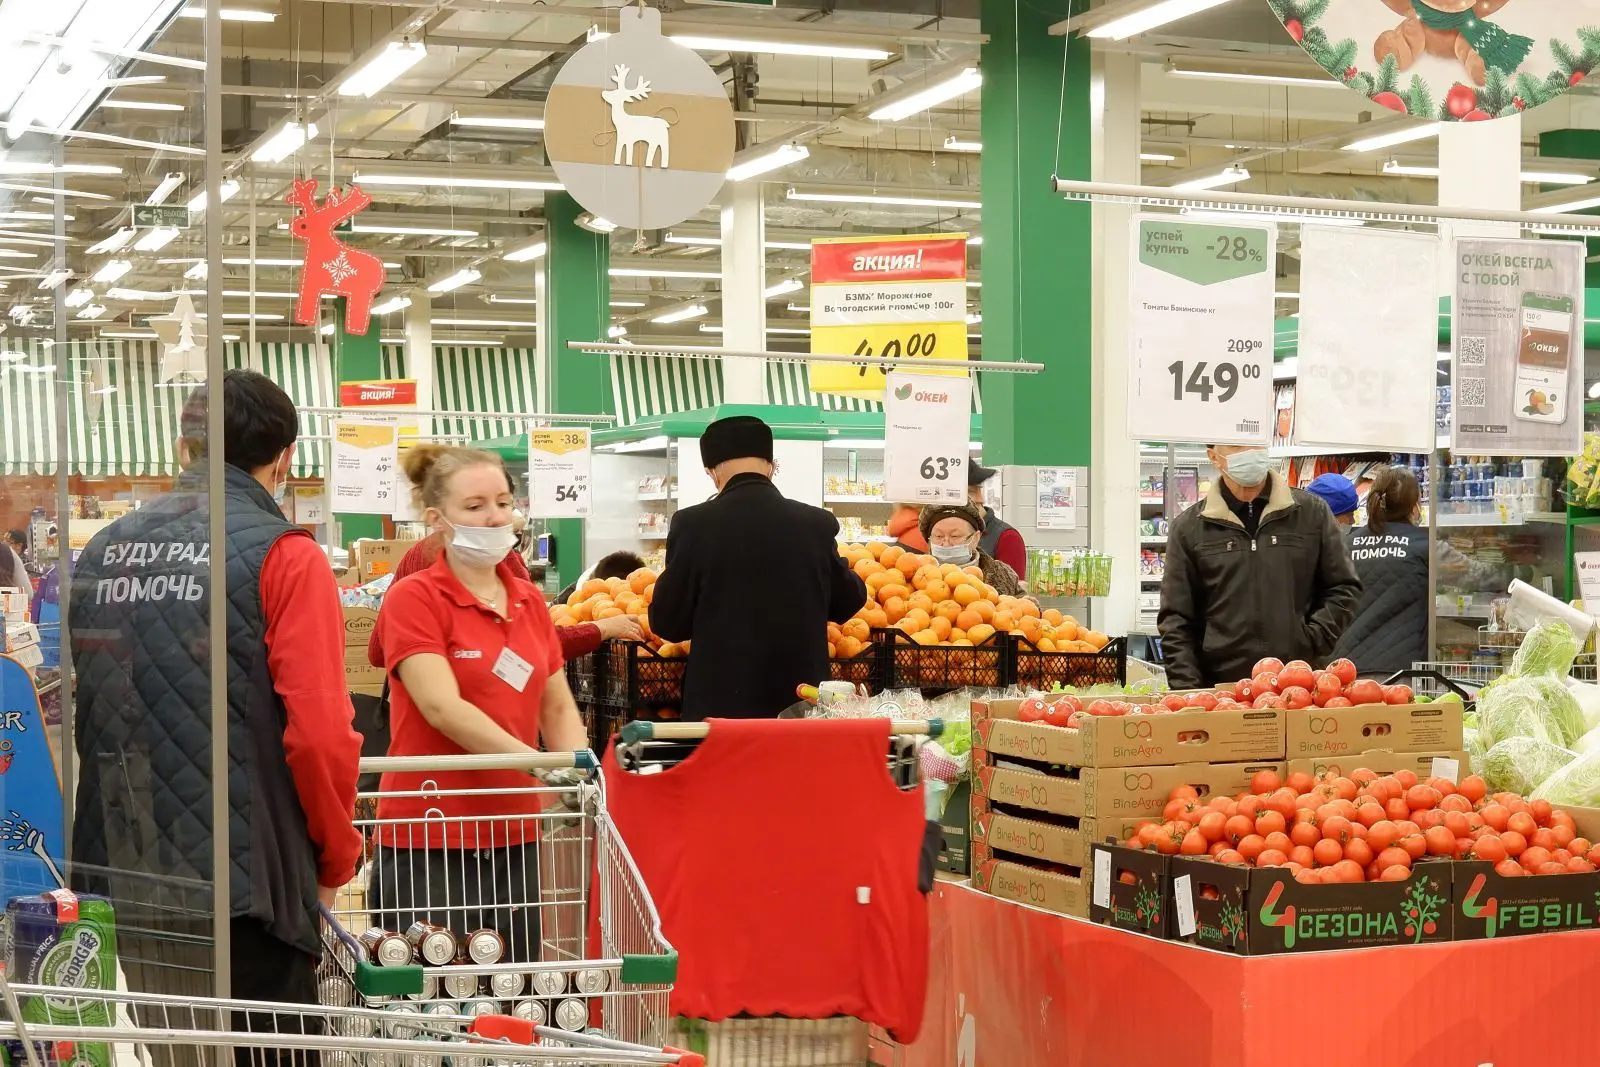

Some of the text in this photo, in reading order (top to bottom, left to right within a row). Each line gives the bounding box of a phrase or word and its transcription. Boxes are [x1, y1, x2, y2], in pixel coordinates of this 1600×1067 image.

[1146, 230, 1183, 242] успей
[1145, 243, 1190, 256] купить
[1206, 236, 1263, 262] -28%
[852, 248, 924, 273] акция!
[1504, 256, 1555, 271] ВСЕГДА
[1461, 272, 1520, 286] С ТОБОЙ
[1142, 302, 1169, 311] Томаты
[360, 387, 396, 401] акция!
[1352, 535, 1410, 546] БУДУ РАД
[102, 542, 210, 567] БУДУ РАД
[1351, 546, 1407, 560] ПОМОЧЬ
[95, 574, 204, 605] ПОМОЧЬ
[349, 620, 372, 629] Calvé
[999, 733, 1029, 752] BineAgro
[1300, 740, 1348, 753] BineAgro
[1113, 744, 1163, 758] BineAgro
[1000, 782, 1030, 802] BineAgro
[1298, 911, 1399, 938] СЕЗОНА
[28, 934, 56, 984] SPECIAL PRICE
